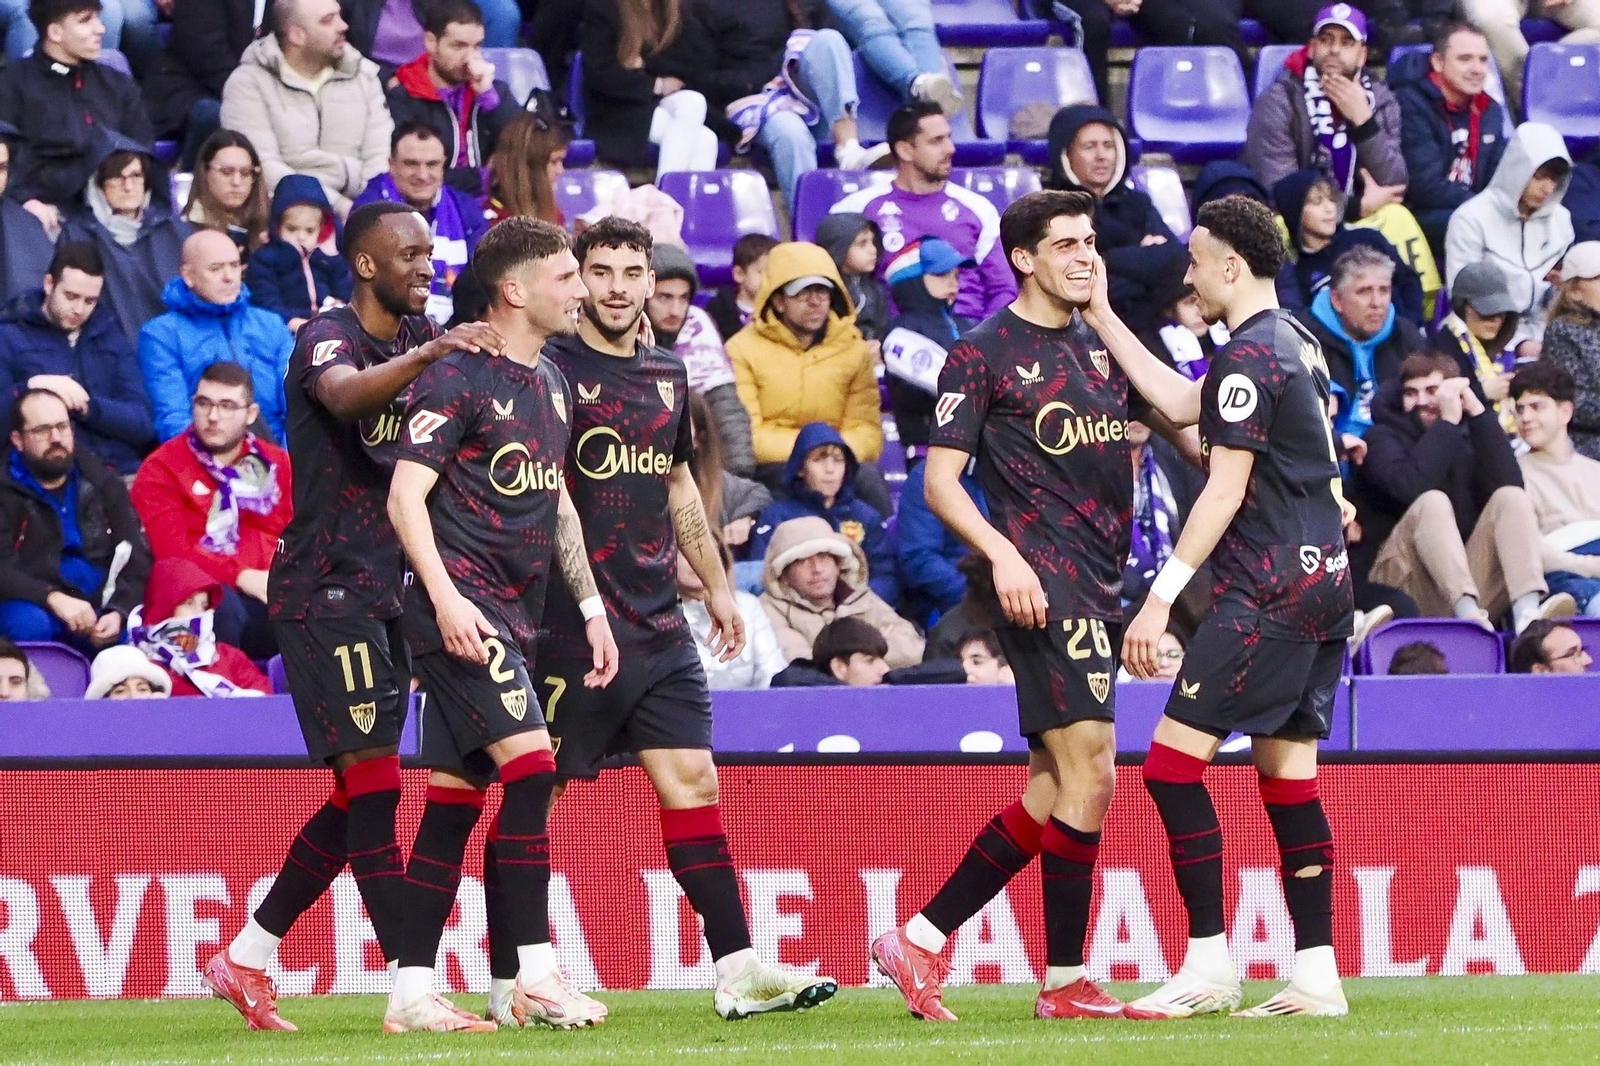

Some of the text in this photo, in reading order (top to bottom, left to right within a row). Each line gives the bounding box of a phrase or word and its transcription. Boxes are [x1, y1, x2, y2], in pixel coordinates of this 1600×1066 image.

[1222, 387, 1252, 409] JD
[483, 637, 515, 684] 2
[1063, 618, 1112, 661] 26
[334, 641, 374, 692] 11
[544, 675, 567, 723] 7
